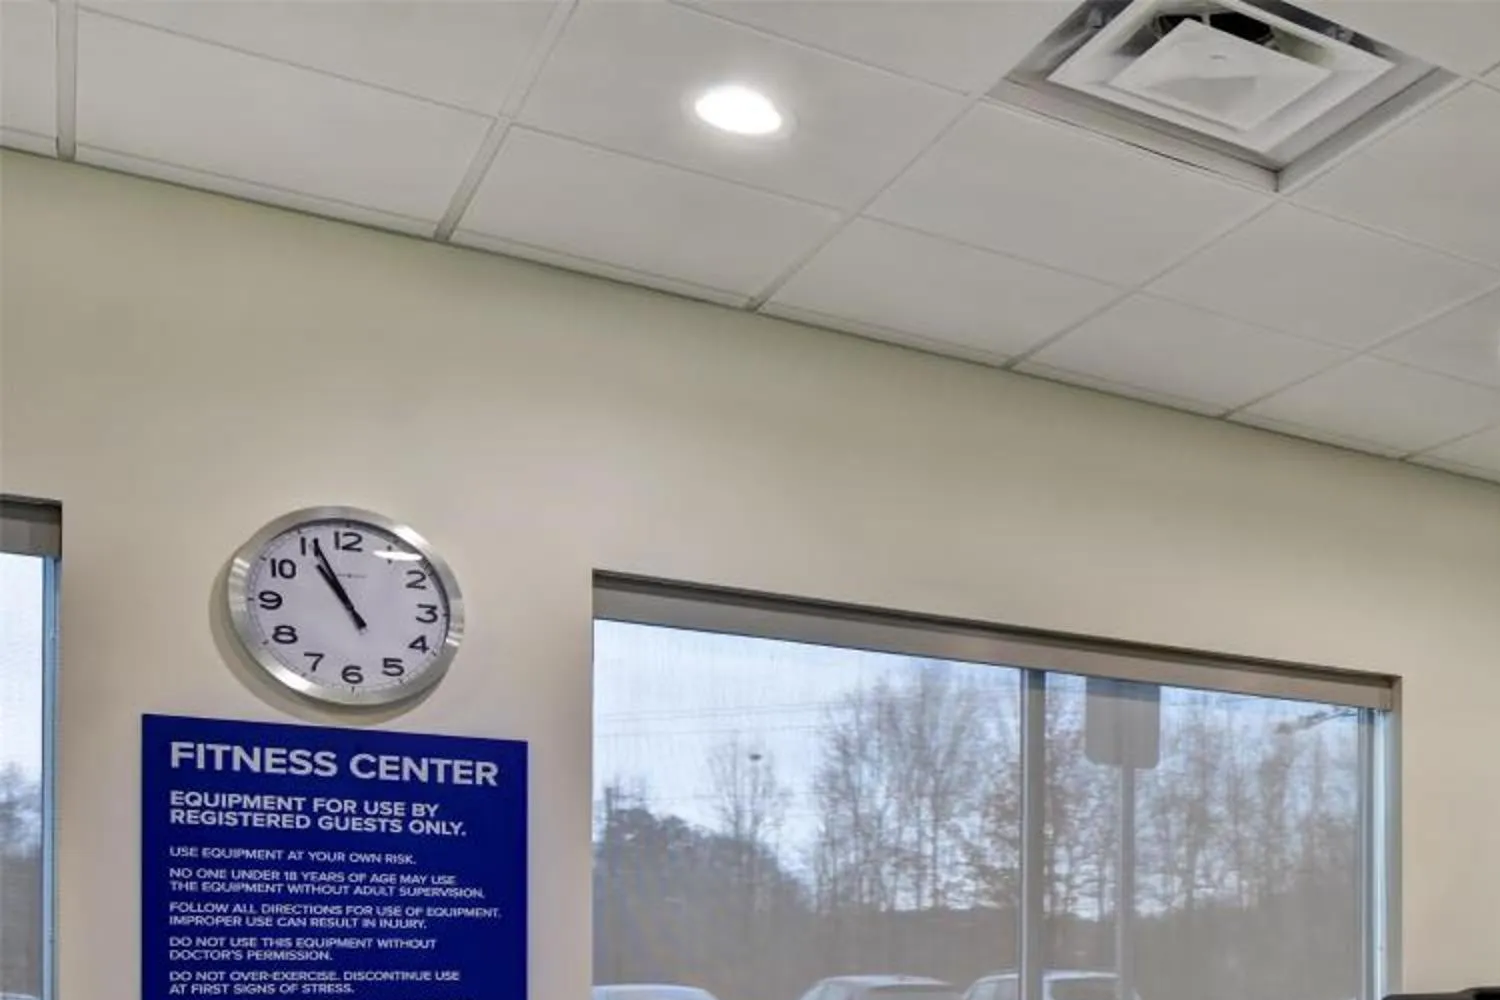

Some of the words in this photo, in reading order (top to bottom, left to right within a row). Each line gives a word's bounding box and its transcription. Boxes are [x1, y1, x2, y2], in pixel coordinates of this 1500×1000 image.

[334, 531, 363, 552] 12
[270, 558, 297, 579] 10
[405, 570, 427, 590] 2
[258, 590, 283, 610] 9
[416, 603, 438, 624] 3
[271, 625, 298, 644] 8
[408, 635, 429, 653] 4
[303, 652, 324, 672] 7
[382, 657, 405, 677] 5
[341, 665, 364, 684] 6
[170, 741, 338, 777] FITNESS
[349, 753, 499, 787] CENTER
[170, 790, 306, 812] EQUIPMENT
[313, 797, 357, 815] FOR
[363, 800, 405, 817] USE
[411, 803, 440, 818] BY
[170, 808, 311, 829] REGISTERED
[317, 815, 403, 833] GUESTS
[408, 819, 467, 836] ONLY.
[169, 846, 198, 858] USE
[201, 847, 284, 861] EQUIPMENT
[287, 850, 304, 861] AT
[308, 850, 346, 863] YOUR
[349, 852, 381, 864] OWN
[385, 853, 416, 865] RISK.
[169, 867, 193, 879] NO
[196, 868, 227, 880] ONE
[231, 869, 280, 881] UNDER
[301, 871, 345, 883] YEARS
[347, 872, 367, 884] OF
[370, 873, 397, 885] AGE
[399, 874, 428, 885] MAY
[431, 875, 457, 886] USE
[170, 881, 198, 892] THE
[201, 881, 285, 894] EQUIPMENT
[287, 884, 350, 895] WITHOUT
[353, 885, 396, 897] ADULT
[399, 886, 485, 899] SUPERVISION.
[169, 902, 229, 914] FOLLOW
[232, 903, 258, 914] ALL
[261, 903, 342, 915] DIRECTIONS
[345, 905, 373, 916] FOR
[376, 905, 401, 917] USE
[405, 906, 424, 917] OF
[169, 915, 242, 927] IMPROPER
[245, 916, 273, 927] USE
[277, 917, 306, 928] CAN
[310, 917, 358, 928] RESULT
[362, 918, 376, 929] IN
[379, 919, 428, 930] INJURY.
[169, 936, 192, 947] DO
[195, 936, 226, 947] NOT
[229, 937, 257, 948] USE
[260, 937, 293, 948] THIS
[295, 937, 373, 949] EQUIPMENT
[377, 938, 437, 949] WITHOUT
[169, 949, 243, 961] DOCTOR'S
[247, 950, 333, 962] PERMISSION.
[169, 971, 193, 982] DO
[195, 971, 226, 982] NOT
[344, 971, 432, 982] DISCONTINUE
[435, 971, 460, 982] USE
[169, 984, 188, 995] AT
[191, 983, 230, 995] FIRST
[233, 983, 276, 995] SIGNS
[279, 983, 299, 994] OF
[302, 983, 355, 994] STRESS.
